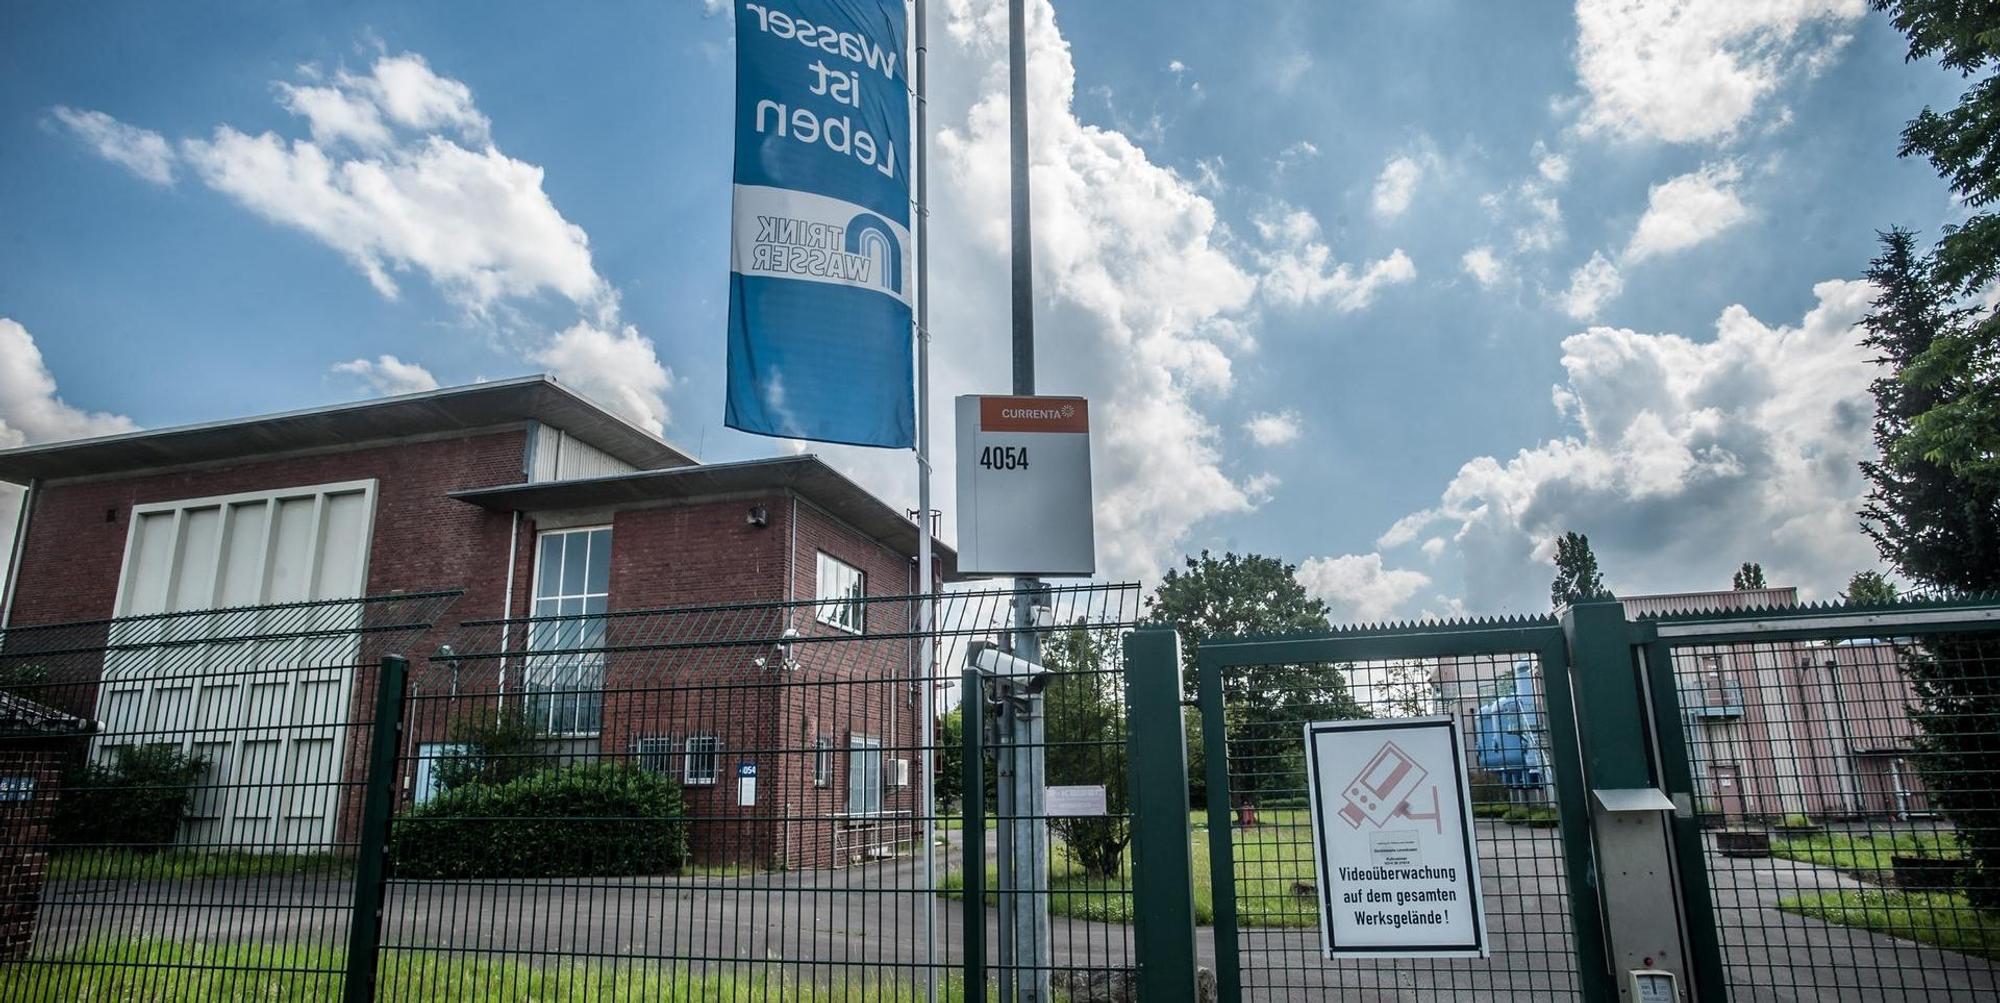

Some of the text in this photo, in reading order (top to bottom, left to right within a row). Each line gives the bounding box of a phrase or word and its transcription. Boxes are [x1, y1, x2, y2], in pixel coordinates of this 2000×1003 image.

[1002, 409, 1061, 419] CURRENTA
[980, 446, 1029, 470] 4054
[739, 766, 756, 774] 054
[1338, 866, 1456, 882] Videoüberwachung
[1343, 888, 1456, 905] auf dem gesamten
